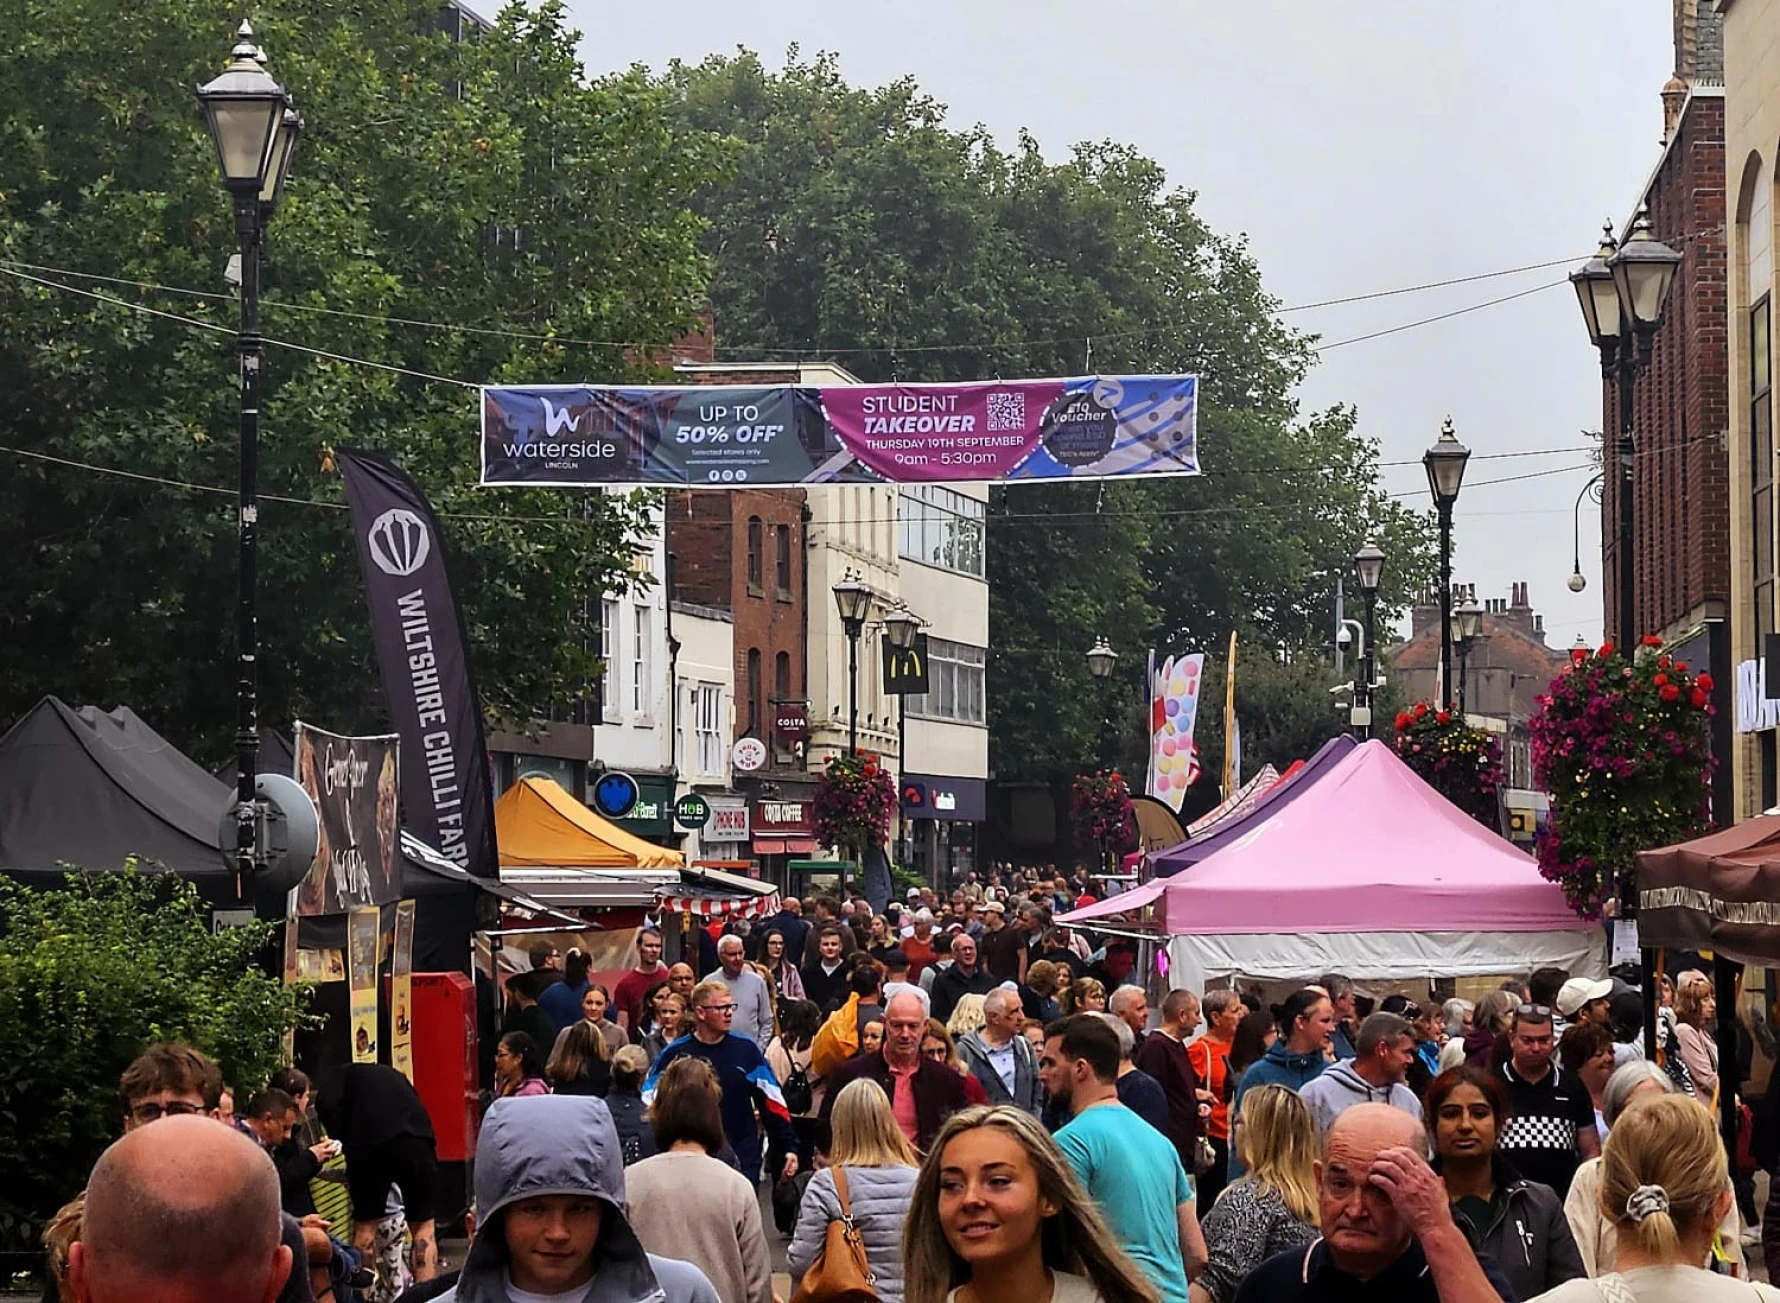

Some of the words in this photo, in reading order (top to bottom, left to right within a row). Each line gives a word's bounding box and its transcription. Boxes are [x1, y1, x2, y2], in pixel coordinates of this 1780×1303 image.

[862, 395, 959, 414] STUDENT
[699, 405, 727, 422] UP
[733, 405, 759, 422] TO
[1052, 411, 1107, 424] Voucher
[864, 415, 976, 434] TAKEOVER
[675, 425, 729, 443] 50%
[502, 440, 616, 458] waterside
[865, 438, 925, 450] THURSDAY
[927, 438, 955, 449] 19TH
[957, 436, 1025, 447] SEPTEMBER
[544, 462, 579, 470] LINCOLN
[894, 453, 928, 465] 9am
[397, 588, 447, 728] WILTSHIRE
[423, 730, 461, 810] CHILLI
[777, 718, 805, 727] COSTA
[782, 804, 803, 822] COFFEE
